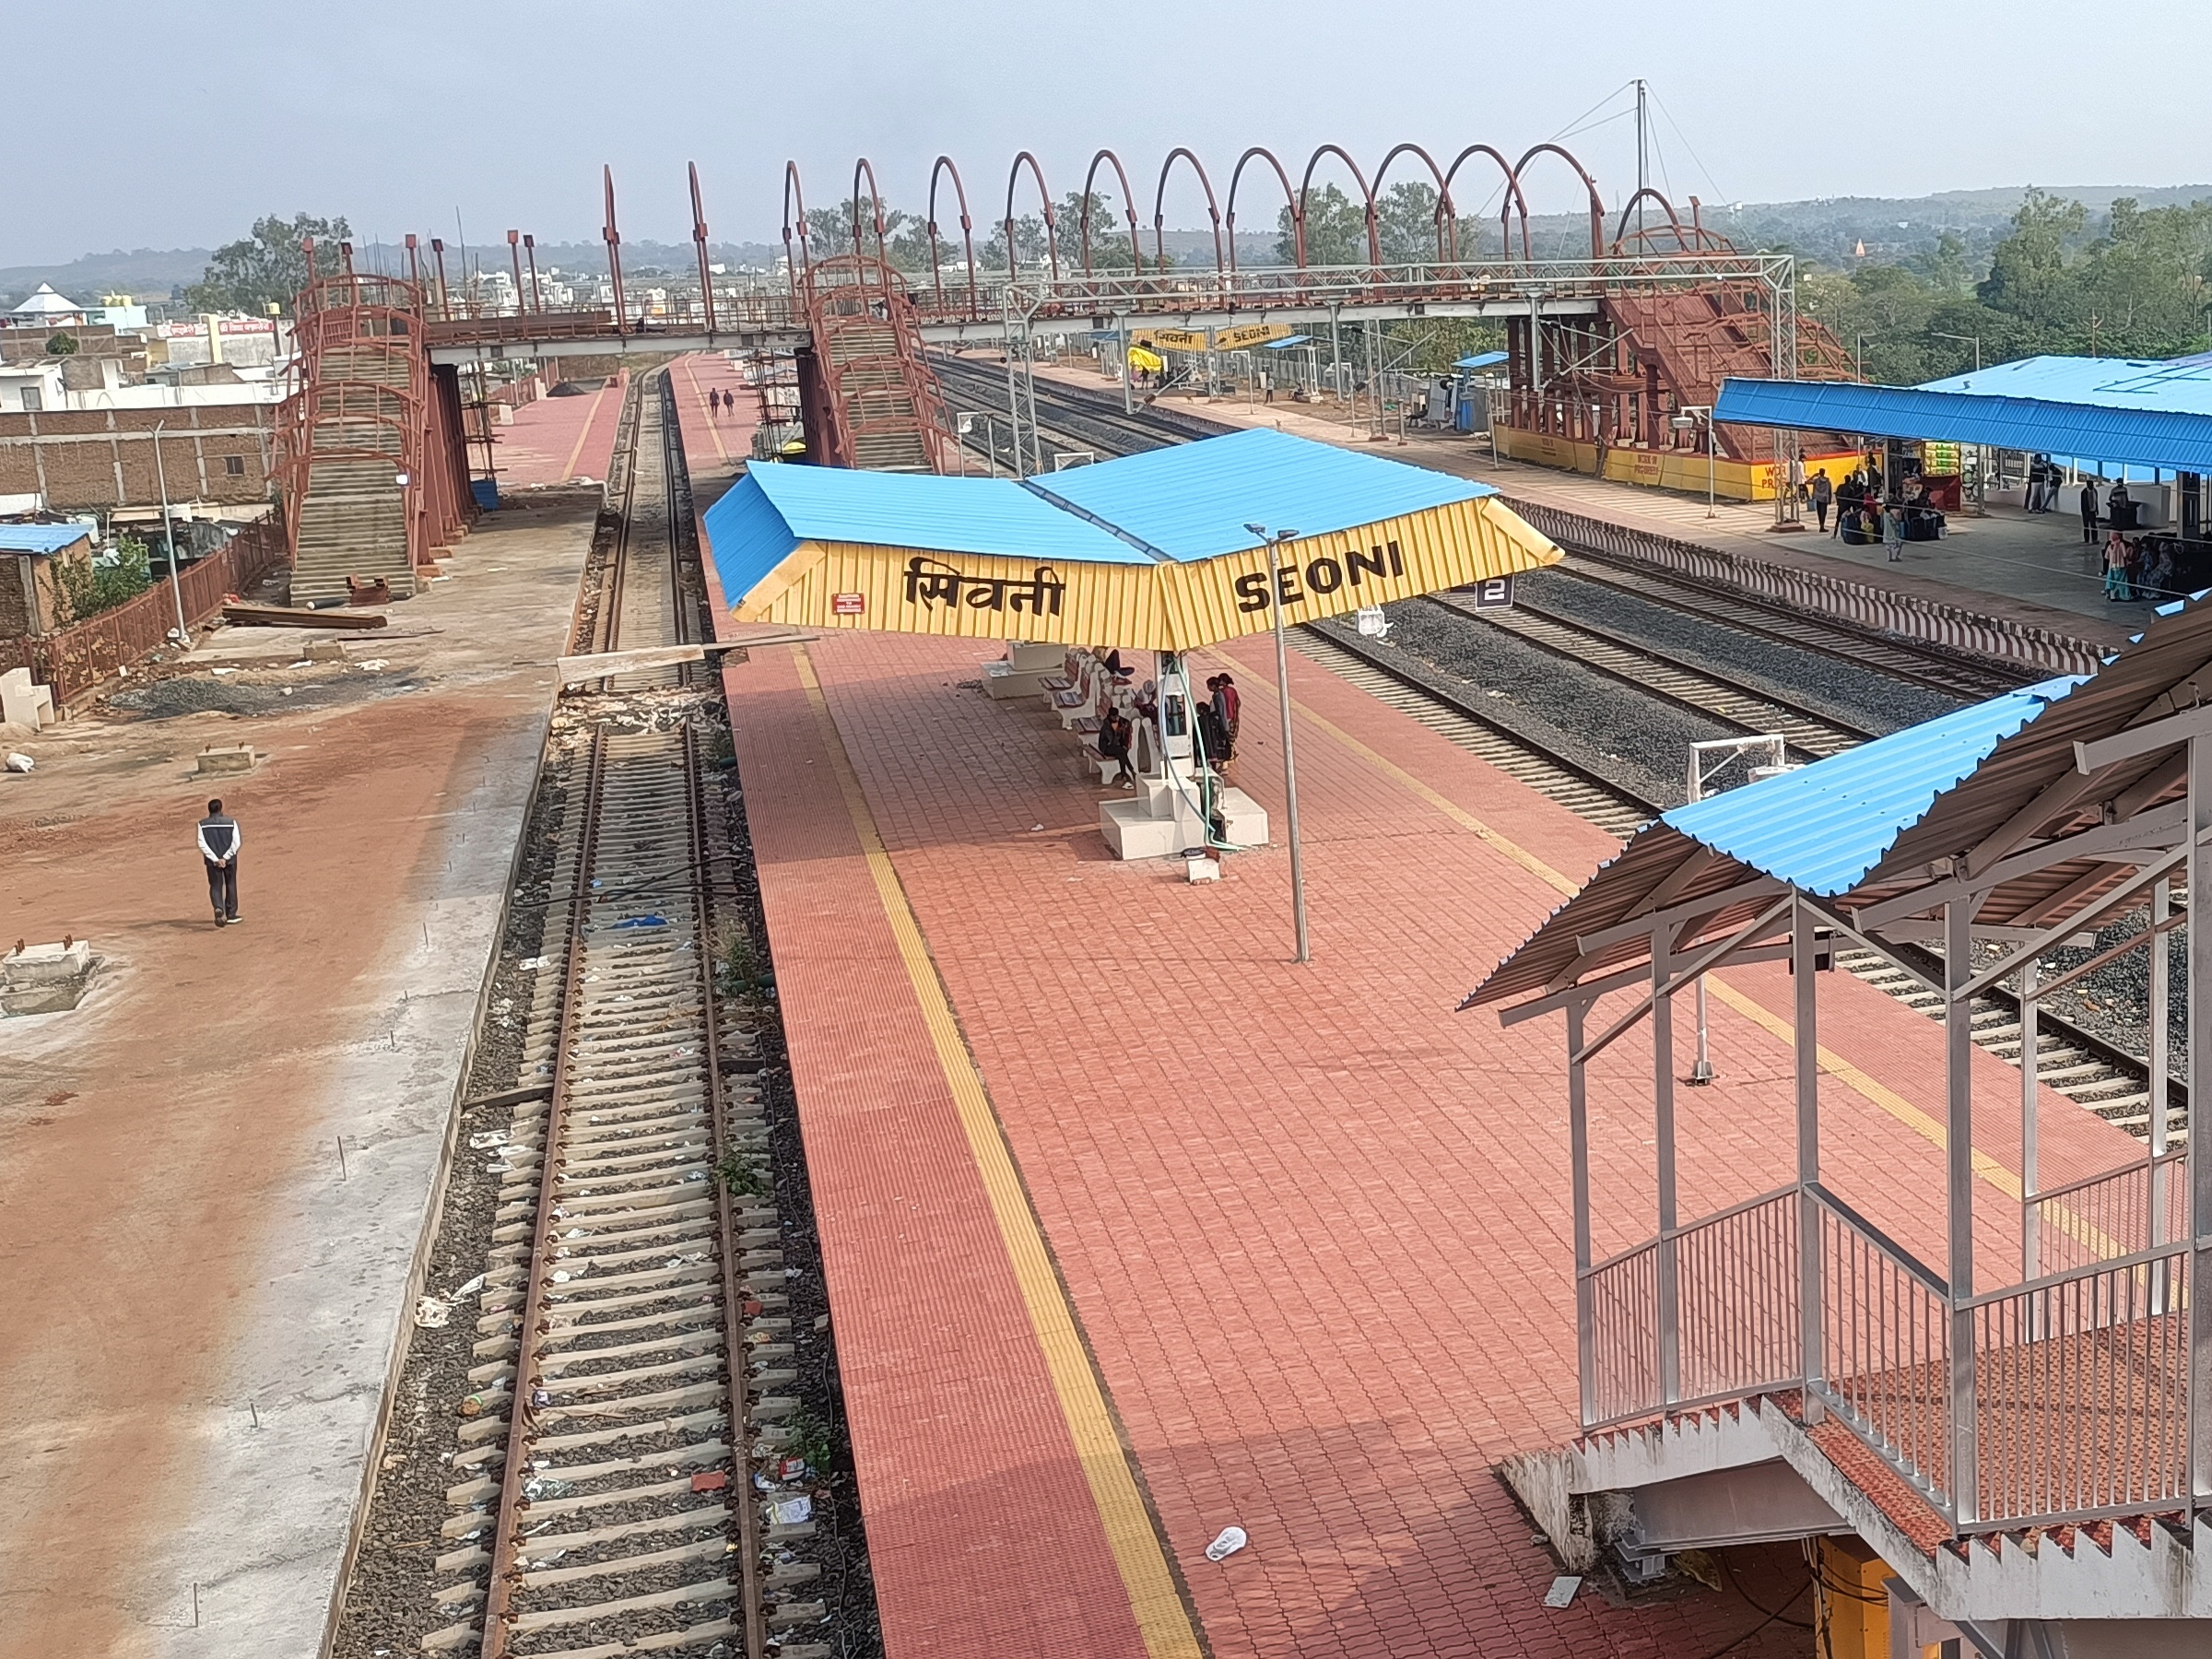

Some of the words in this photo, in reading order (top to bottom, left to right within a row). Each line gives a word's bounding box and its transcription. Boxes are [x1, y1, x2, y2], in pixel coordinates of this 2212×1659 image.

[903, 556, 1065, 618] सिवनी
[1234, 540, 1404, 614] SEONI
[1484, 579, 1506, 601] 2
